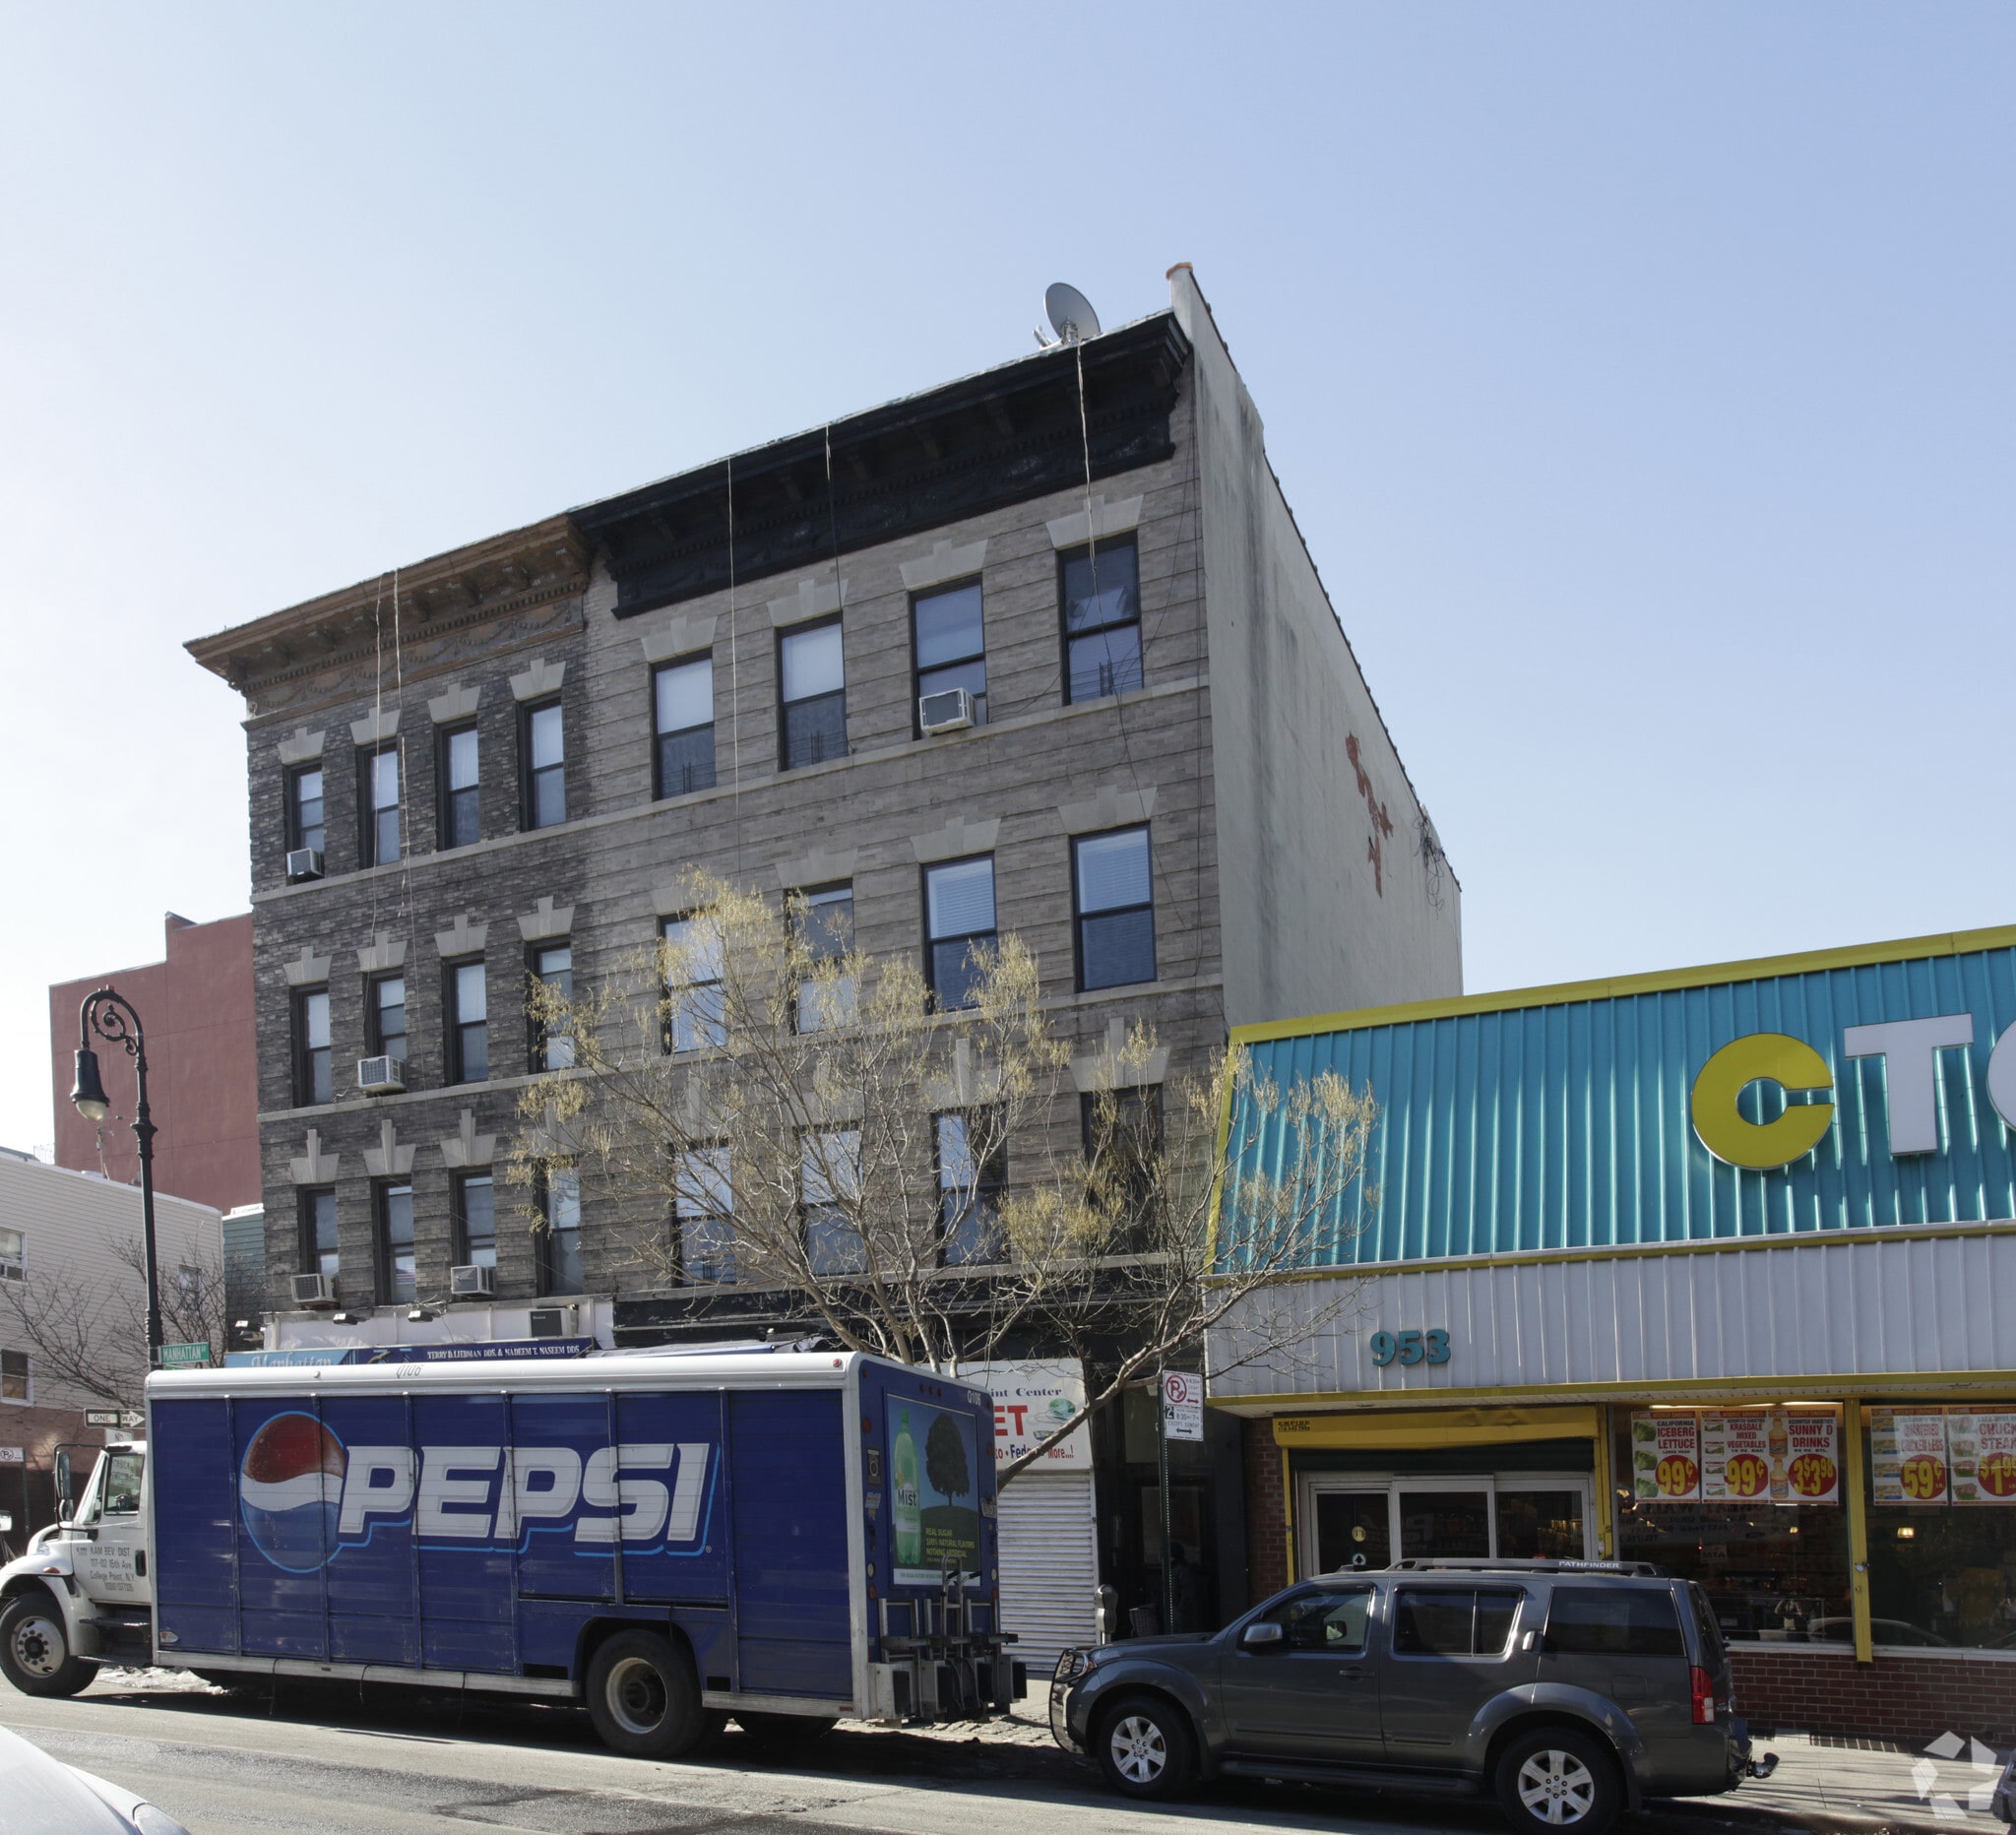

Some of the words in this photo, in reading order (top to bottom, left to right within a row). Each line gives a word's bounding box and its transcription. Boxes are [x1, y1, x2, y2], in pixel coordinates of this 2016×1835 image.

[1691, 1013, 2016, 1171] CT
[162, 1346, 201, 1360] MANHATTAN
[427, 1351, 447, 1360] TERRY
[505, 1348, 532, 1357] NADEEM
[539, 1346, 566, 1356] NASEEM
[1370, 1329, 1451, 1366] 953
[1015, 1387, 1062, 1397] Center
[1658, 1427, 1695, 1437] ICEBERG
[1789, 1424, 1822, 1435] SUNNY
[1826, 1424, 1833, 1435] D
[1658, 1438, 1695, 1449] LETTUCE
[1793, 1437, 1830, 1448] DRINKS
[338, 1443, 710, 1543] PEPSI
[898, 1489, 917, 1506] Mist
[1558, 1560, 1620, 1569] PATHFINDER
